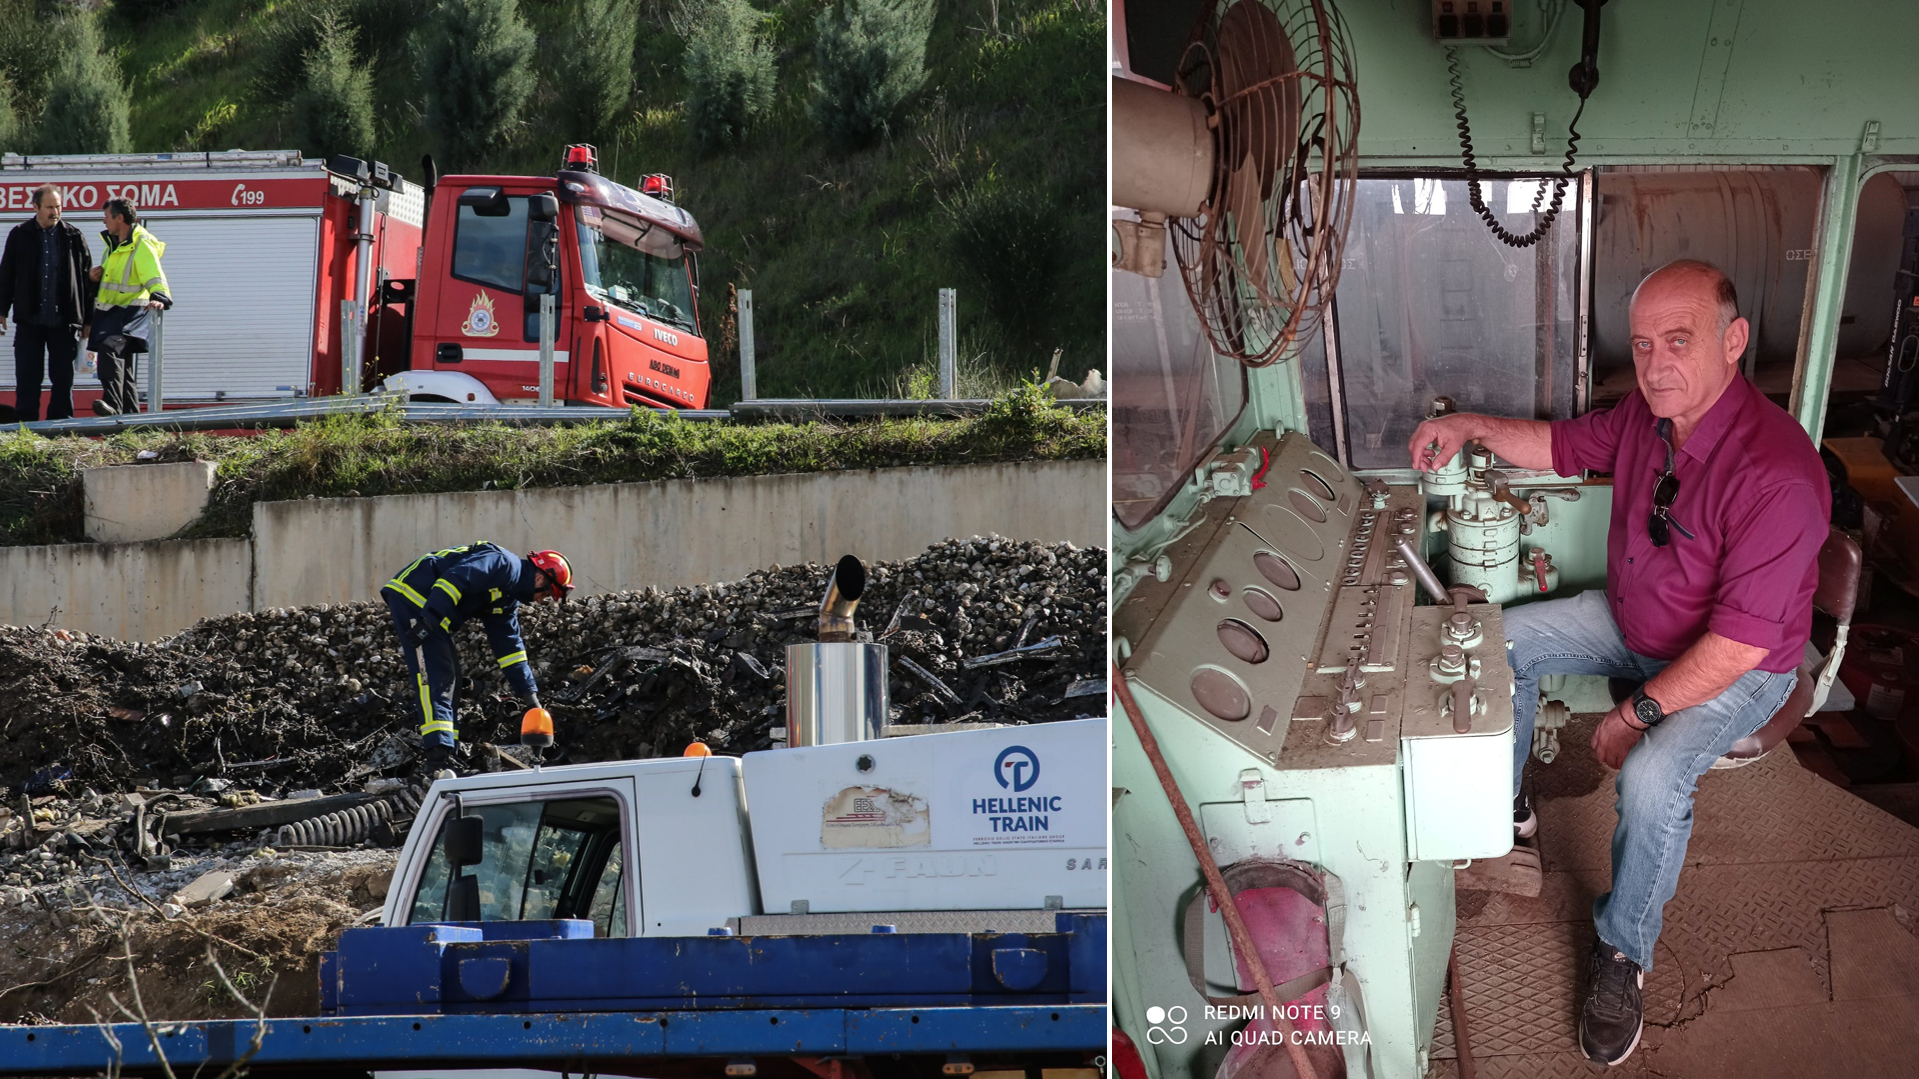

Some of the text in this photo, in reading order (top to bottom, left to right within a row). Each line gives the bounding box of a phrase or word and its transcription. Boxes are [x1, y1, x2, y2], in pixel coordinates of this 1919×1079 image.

[106, 184, 179, 207] ΣΩΜΑ
[240, 191, 265, 205] 199
[653, 328, 678, 347] IVECO
[628, 372, 695, 402] EUROCARGO
[972, 796, 1062, 815] HELLENIC
[989, 815, 1049, 832] TRAIN
[885, 854, 996, 878] FAUN
